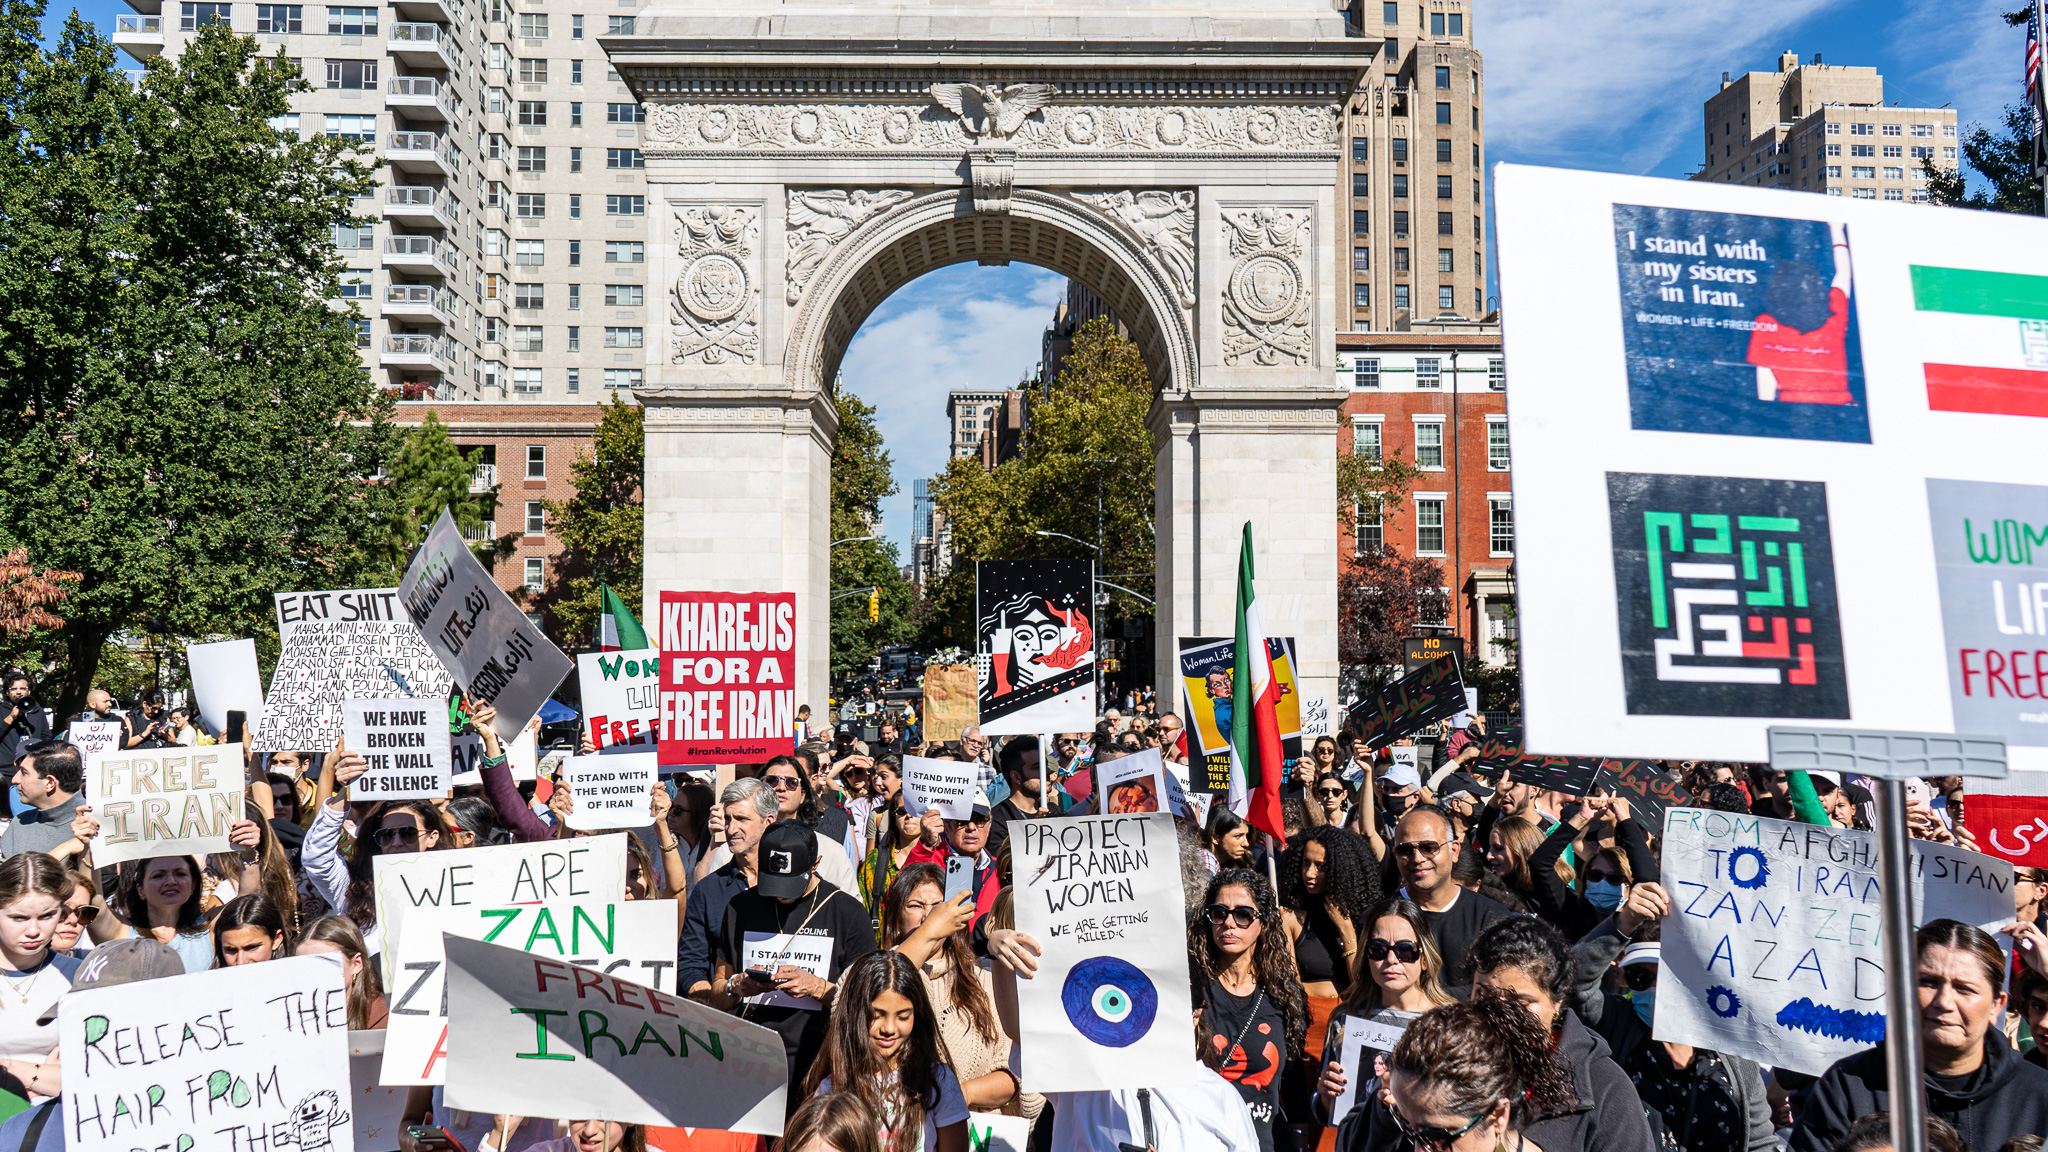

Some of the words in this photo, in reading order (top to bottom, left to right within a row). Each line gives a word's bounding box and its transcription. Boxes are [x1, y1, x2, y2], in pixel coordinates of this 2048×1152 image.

[1628, 231, 1636, 250] I
[1644, 235, 1707, 257] stand
[1713, 239, 1767, 261] with
[1644, 261, 1682, 286] my
[1689, 260, 1758, 285] sisters
[1660, 285, 1685, 303] in
[1692, 284, 1745, 308] Iran.
[1636, 312, 1683, 326] WOMEN
[1690, 316, 1715, 329] LIFE
[1723, 319, 1779, 332] FREEDOM
[404, 565, 443, 631] WOMEN
[279, 593, 331, 624] EAT
[338, 593, 396, 622] SHIT
[291, 623, 325, 636] MAHSA
[326, 622, 358, 635] AMINI
[364, 622, 387, 635] NIKA
[439, 609, 472, 658] LIFE
[662, 602, 793, 652] KHAREJIS
[285, 635, 345, 647] MOHAMMAD
[348, 633, 390, 646] HOSSEIN
[1423, 638, 1440, 649] NO
[282, 647, 328, 658] MOHSEN
[329, 645, 383, 657] GHEISARI
[1411, 650, 1452, 659] ALCOHO
[279, 657, 345, 670] AZARNOUSH
[354, 656, 411, 670] ROOZBEH
[418, 659, 450, 671] KHA
[672, 657, 750, 685] FOR
[755, 657, 784, 684] A
[276, 669, 298, 682] EMI
[306, 668, 340, 681] MILAN
[406, 670, 429, 682] ALI
[270, 681, 315, 692] ZAFFARI
[322, 680, 349, 692] AMIR
[352, 680, 403, 693] FOULADI
[412, 682, 451, 694] MILAD
[268, 693, 296, 705] ZARE
[307, 691, 345, 704] SARINA
[271, 704, 325, 717] SETAREH
[363, 711, 386, 727] WE
[390, 710, 427, 726] HAVE
[660, 690, 724, 741] FREE
[728, 689, 794, 739] IRAN
[259, 717, 278, 729] EIN
[285, 716, 320, 728] SHAMS
[75, 733, 113, 742] WOMAN
[254, 728, 313, 741] MEHRDAD
[367, 732, 425, 748] BROKEN
[251, 739, 332, 751] JAMALZADEH
[687, 745, 767, 757] #IranRevolution
[365, 754, 389, 770] THE
[394, 753, 434, 769] WALL
[1206, 755, 1210, 763] I
[101, 754, 218, 798] FREE
[359, 776, 377, 793] OF
[381, 775, 439, 792] SILENCE
[570, 774, 574, 783] I
[577, 773, 616, 783] STAND
[619, 771, 648, 780] WITH
[908, 770, 912, 778] I
[913, 771, 943, 782] STAND
[944, 776, 970, 785] WITH
[1207, 772, 1223, 781] THE
[575, 787, 598, 796] THE
[601, 785, 645, 795] WOMEN
[910, 783, 927, 792] THE
[928, 786, 964, 796] WOMEN
[1172, 786, 1198, 799] WOMEN
[587, 801, 602, 810] OF
[606, 799, 633, 809] IRAN
[917, 796, 929, 804] OF
[1170, 795, 1186, 805] WITH
[103, 791, 241, 846] IRAN
[1024, 817, 1151, 856] PROTECT
[1666, 810, 1761, 846] FROM
[1778, 825, 2009, 895] AFGHISTAN
[1052, 849, 1149, 882] IRANIAN
[400, 864, 475, 907] WE
[511, 848, 591, 902] ARE
[1046, 878, 1135, 914] WOMEN
[1678, 880, 1786, 928] ZAN
[480, 903, 615, 955] ZAN
[1050, 923, 1071, 937] WE
[1074, 918, 1099, 934] ARE
[1102, 910, 1149, 929] GETTING
[751, 950, 755, 958] I
[757, 951, 791, 960] STAND
[794, 952, 822, 962] WITH
[533, 959, 680, 1019] FREE
[83, 1008, 244, 1078] RELEASE
[265, 987, 348, 1037] THE
[510, 1007, 724, 1061] IRAN
[73, 1083, 171, 1143] HAIR
[185, 1064, 287, 1125] FROM
